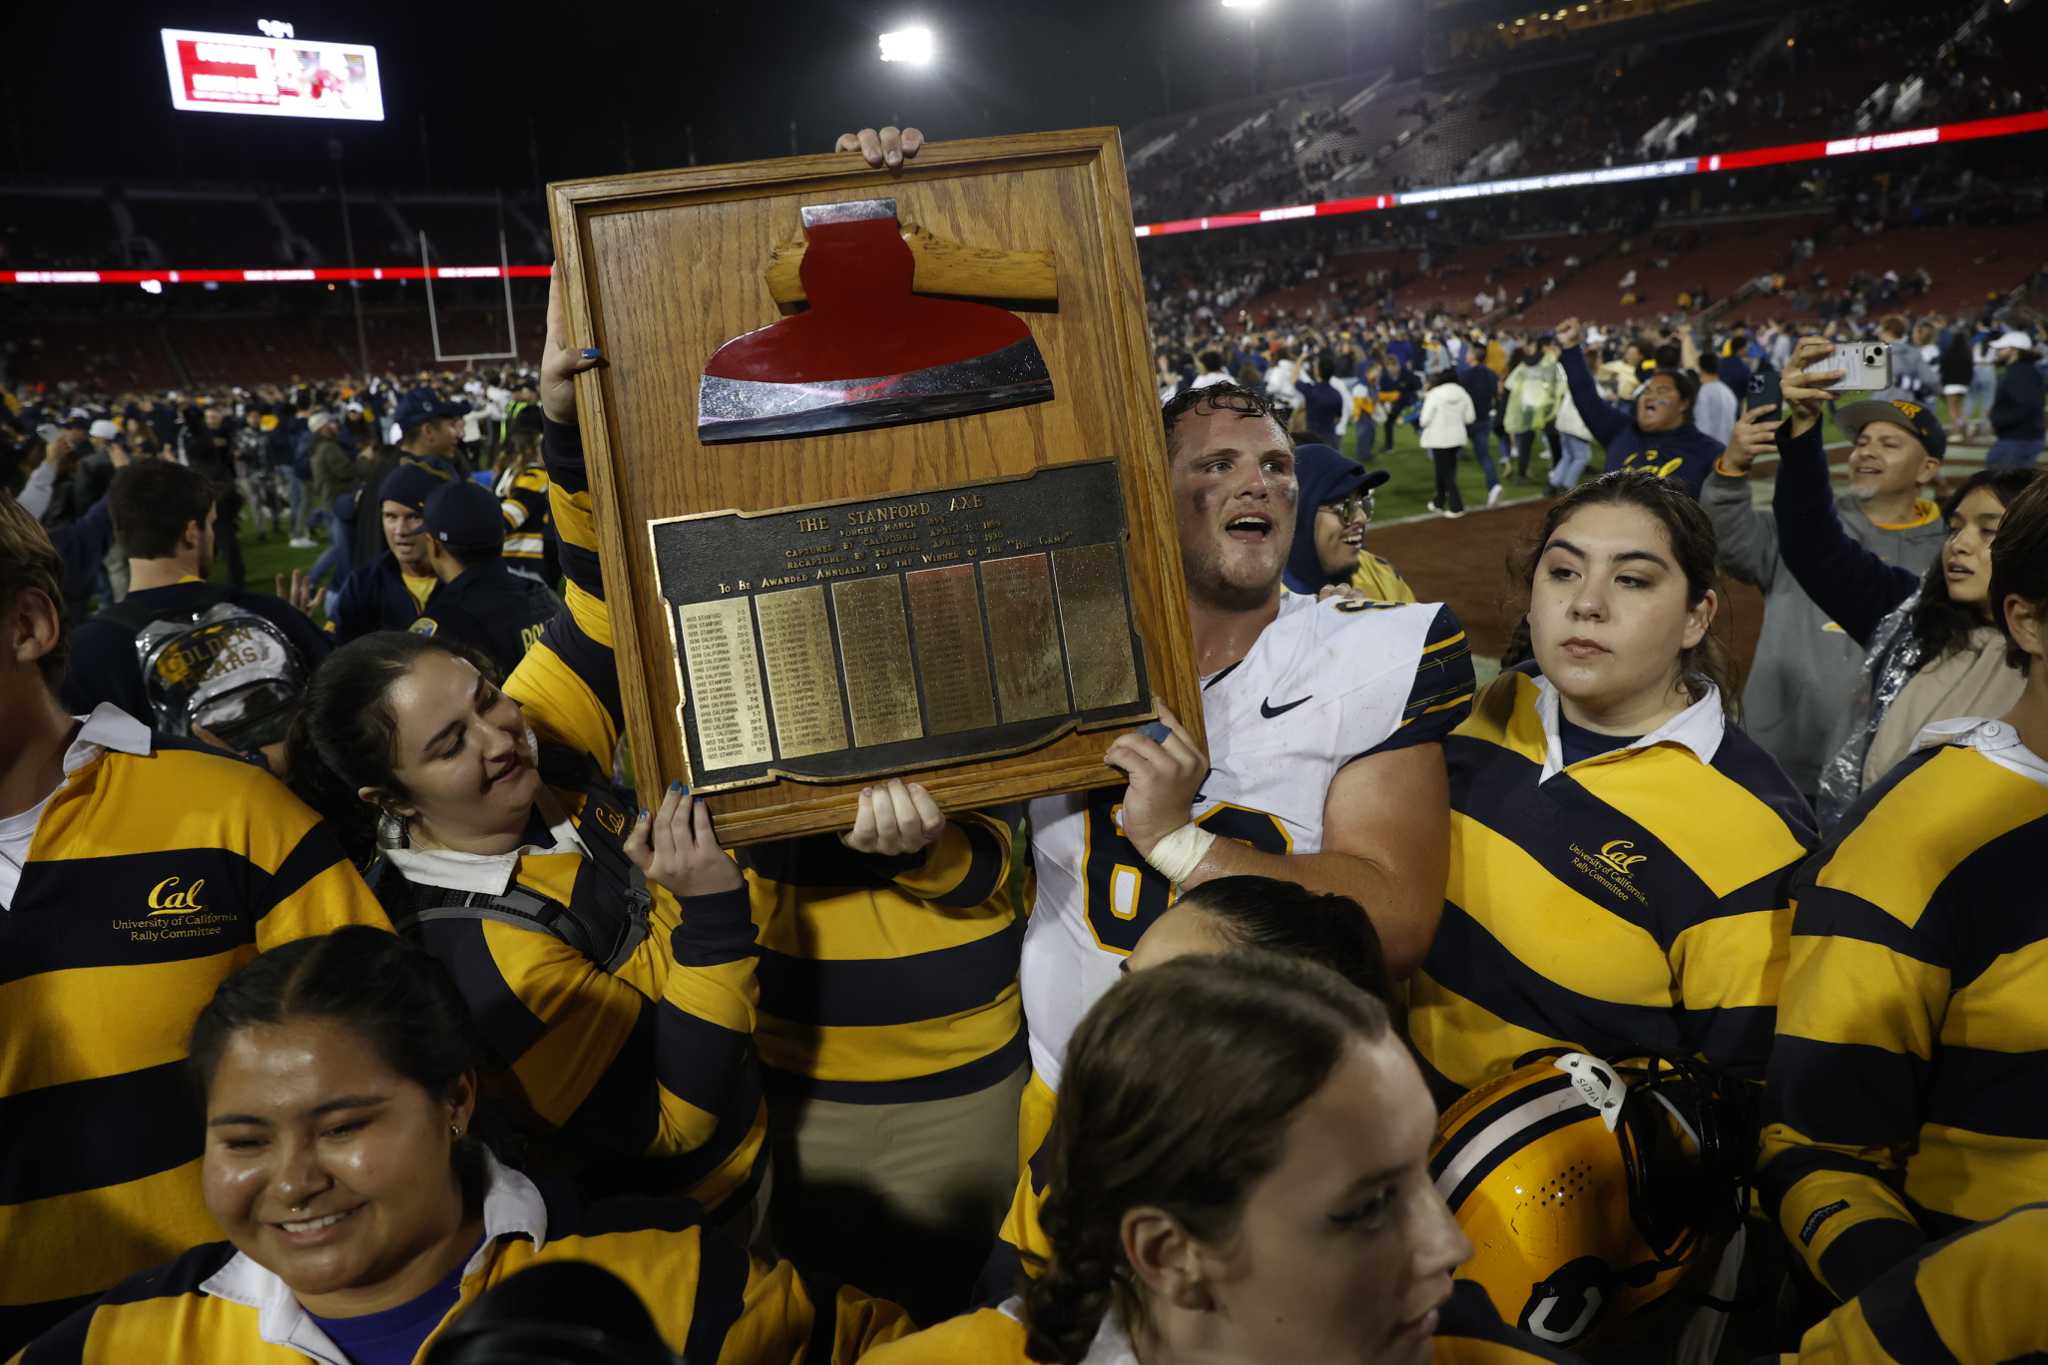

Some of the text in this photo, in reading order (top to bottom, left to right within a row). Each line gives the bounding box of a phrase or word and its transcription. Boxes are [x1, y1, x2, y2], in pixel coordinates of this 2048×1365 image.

[797, 495, 985, 533] THE STANFORD AXE
[1569, 842, 1646, 902] University of California
[1593, 840, 1648, 874] Cal
[147, 876, 205, 917] Cal
[1572, 857, 1629, 901] Rally Committee
[112, 911, 238, 930] University of California
[130, 926, 221, 942] Rally Committee
